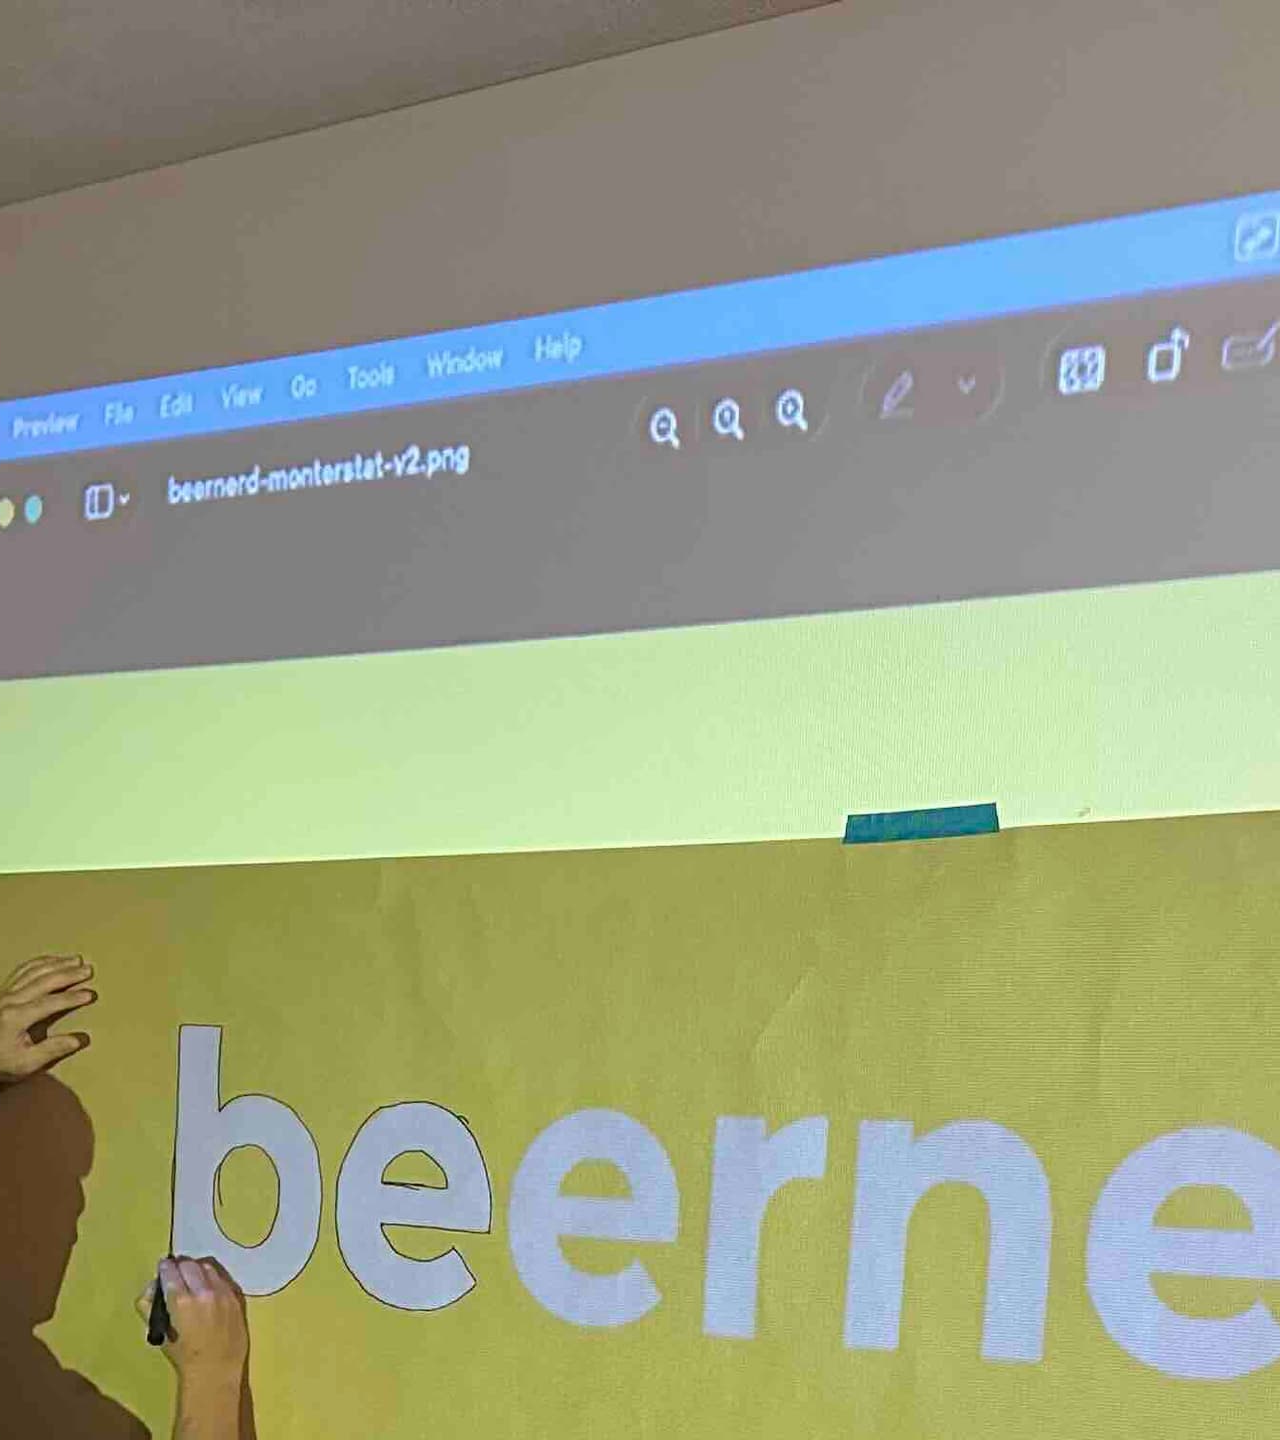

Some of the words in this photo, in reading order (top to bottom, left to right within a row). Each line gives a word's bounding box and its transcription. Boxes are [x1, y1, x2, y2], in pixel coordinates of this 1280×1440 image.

[12, 412, 80, 438] Preview
[103, 402, 134, 426] File
[160, 389, 193, 418] Edit
[221, 383, 264, 409] View
[290, 373, 317, 399] Go
[347, 361, 396, 389] Tools
[426, 346, 504, 378] Window
[534, 331, 583, 363] Help
